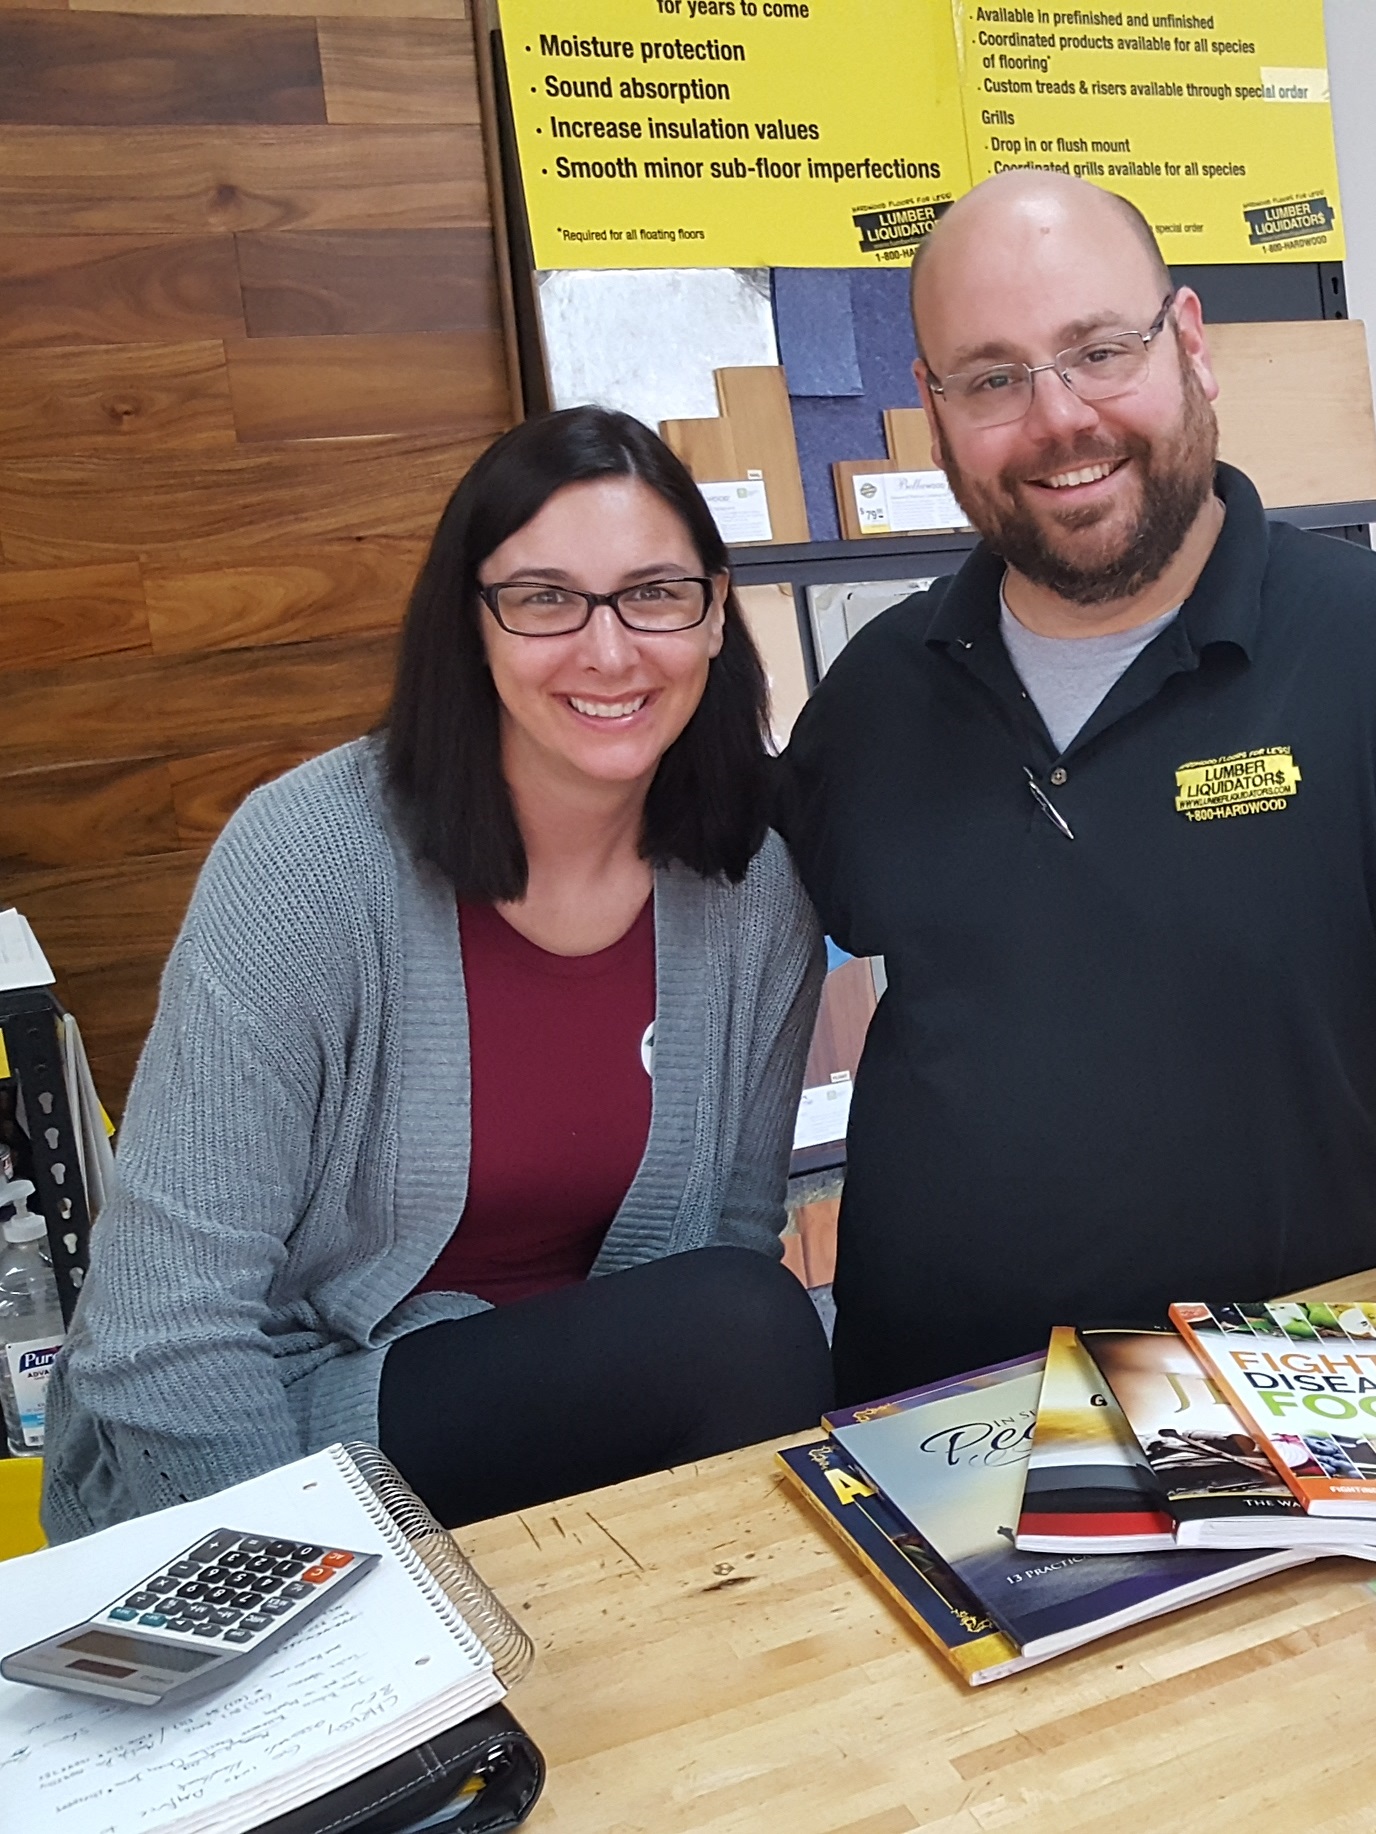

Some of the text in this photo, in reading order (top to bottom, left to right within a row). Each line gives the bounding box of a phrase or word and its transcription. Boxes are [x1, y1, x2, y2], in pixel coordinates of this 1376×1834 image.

[657, 0, 809, 19] for years to come
[976, 7, 1214, 30] Available in prefinished and unfinished
[540, 34, 746, 63] Moisture protection
[978, 31, 1255, 55] Coordinated products available for all species
[982, 54, 996, 69] of
[545, 75, 730, 103] Sound absorption
[983, 78, 1309, 101] Custom treads & risers available through special order
[981, 110, 1015, 126] Grills
[551, 117, 820, 141] Increase insulation values
[991, 136, 1131, 154] Drop in or flush mount
[556, 156, 941, 183] Smooth minor sub-floor imperfections
[1074, 162, 1105, 178] grills
[1108, 162, 1161, 176] available
[1164, 162, 1181, 176] for
[1184, 162, 1199, 176] all
[1202, 162, 1246, 179] species
[879, 207, 935, 226] LUMBER
[1265, 203, 1312, 221] LUMBER
[609, 229, 623, 241] for
[626, 229, 638, 240] all
[640, 228, 676, 242] floating
[678, 228, 705, 240] floors
[1155, 223, 1204, 234] special order
[1262, 235, 1327, 254] 1-800-HARDWOOD
[1248, 747, 1265, 758] FOR
[1205, 759, 1266, 782] LUMBER
[1185, 798, 1287, 822] 1-800-HARDWOOD
[28, 1369, 50, 1378] ADVA
[993, 1416, 1015, 1427] IN
[1242, 1499, 1275, 1507] THE
[1006, 1573, 1023, 1585] 13
